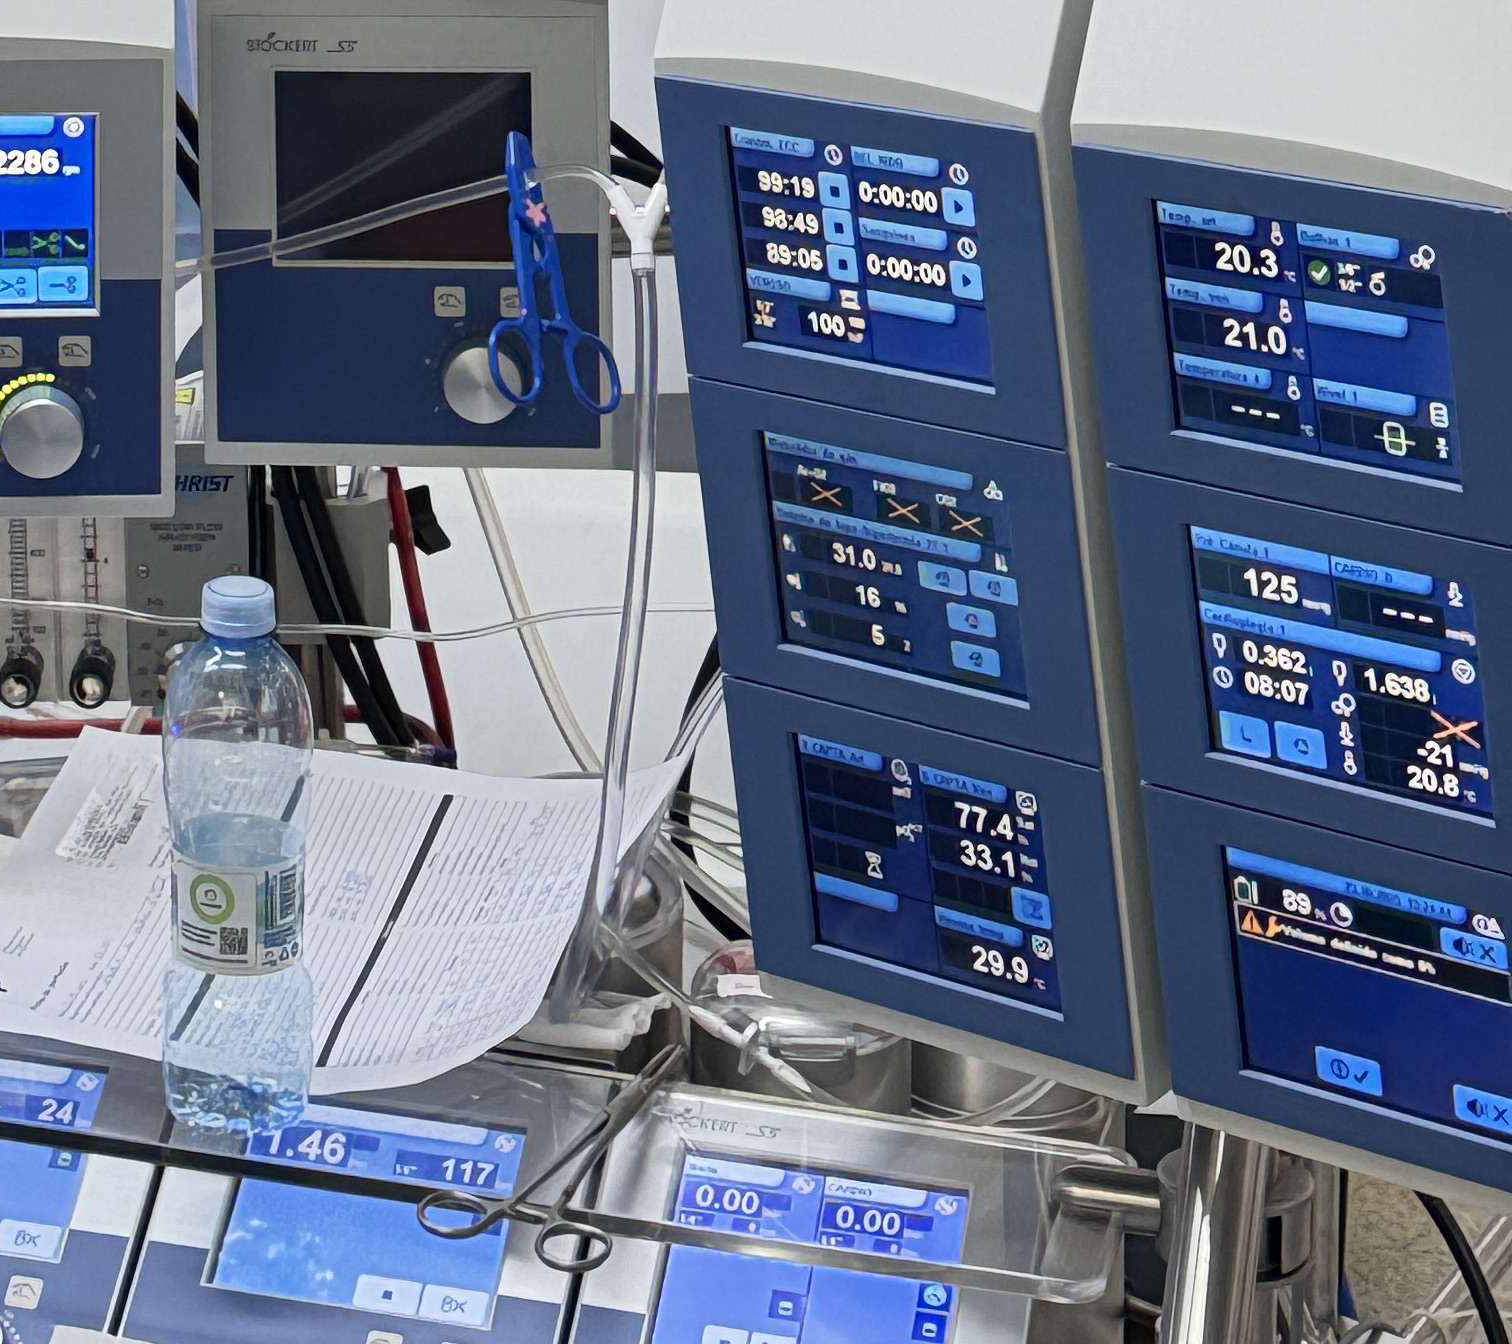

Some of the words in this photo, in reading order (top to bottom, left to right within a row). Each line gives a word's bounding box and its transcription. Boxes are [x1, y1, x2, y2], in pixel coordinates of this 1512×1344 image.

[757, 170, 815, 199] 99:19
[858, 180, 938, 213] 0:00:00
[761, 206, 819, 234] 98:49
[766, 242, 823, 272] 89:05
[866, 253, 946, 287] 0:00:00
[1214, 241, 1279, 278] 20.3
[807, 311, 845, 338] 100
[1222, 317, 1287, 355] 21.0
[175, 475, 235, 493] HRIST
[831, 541, 876, 570] 31.0
[854, 584, 881, 608] 16
[1243, 567, 1298, 604] 125
[871, 624, 885, 646] 5
[1242, 639, 1307, 674] 0.362
[1244, 671, 1309, 705] 08:07
[1363, 667, 1431, 703] 1.638
[1416, 739, 1455, 768] -21
[1406, 763, 1460, 798] 20.8
[954, 801, 1014, 841] 77.4
[959, 839, 1015, 879] 33.1
[1281, 888, 1312, 915] 89
[971, 944, 1029, 984] 29.9
[38, 1098, 75, 1124] 24
[260, 1128, 346, 1163] 1.46
[442, 1158, 495, 1185] 117
[695, 1184, 760, 1214] 0.00
[836, 1205, 901, 1236] 0.00
